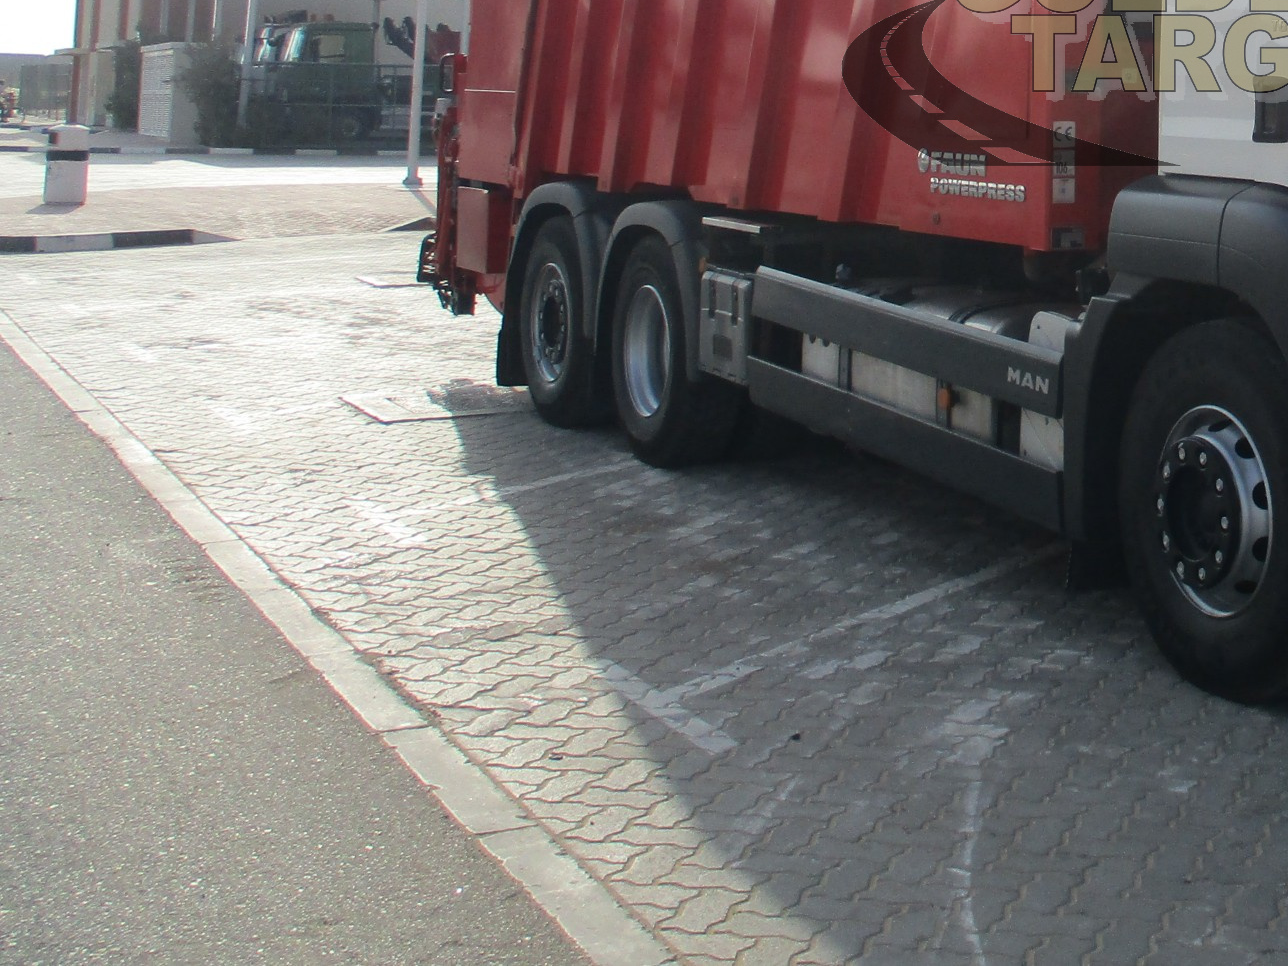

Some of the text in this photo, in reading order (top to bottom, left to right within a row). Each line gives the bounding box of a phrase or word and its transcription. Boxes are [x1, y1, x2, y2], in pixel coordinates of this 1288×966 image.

[930, 151, 987, 177] FAUN
[930, 177, 1026, 203] POWERPRESS
[1007, 365, 1050, 395] MAN
